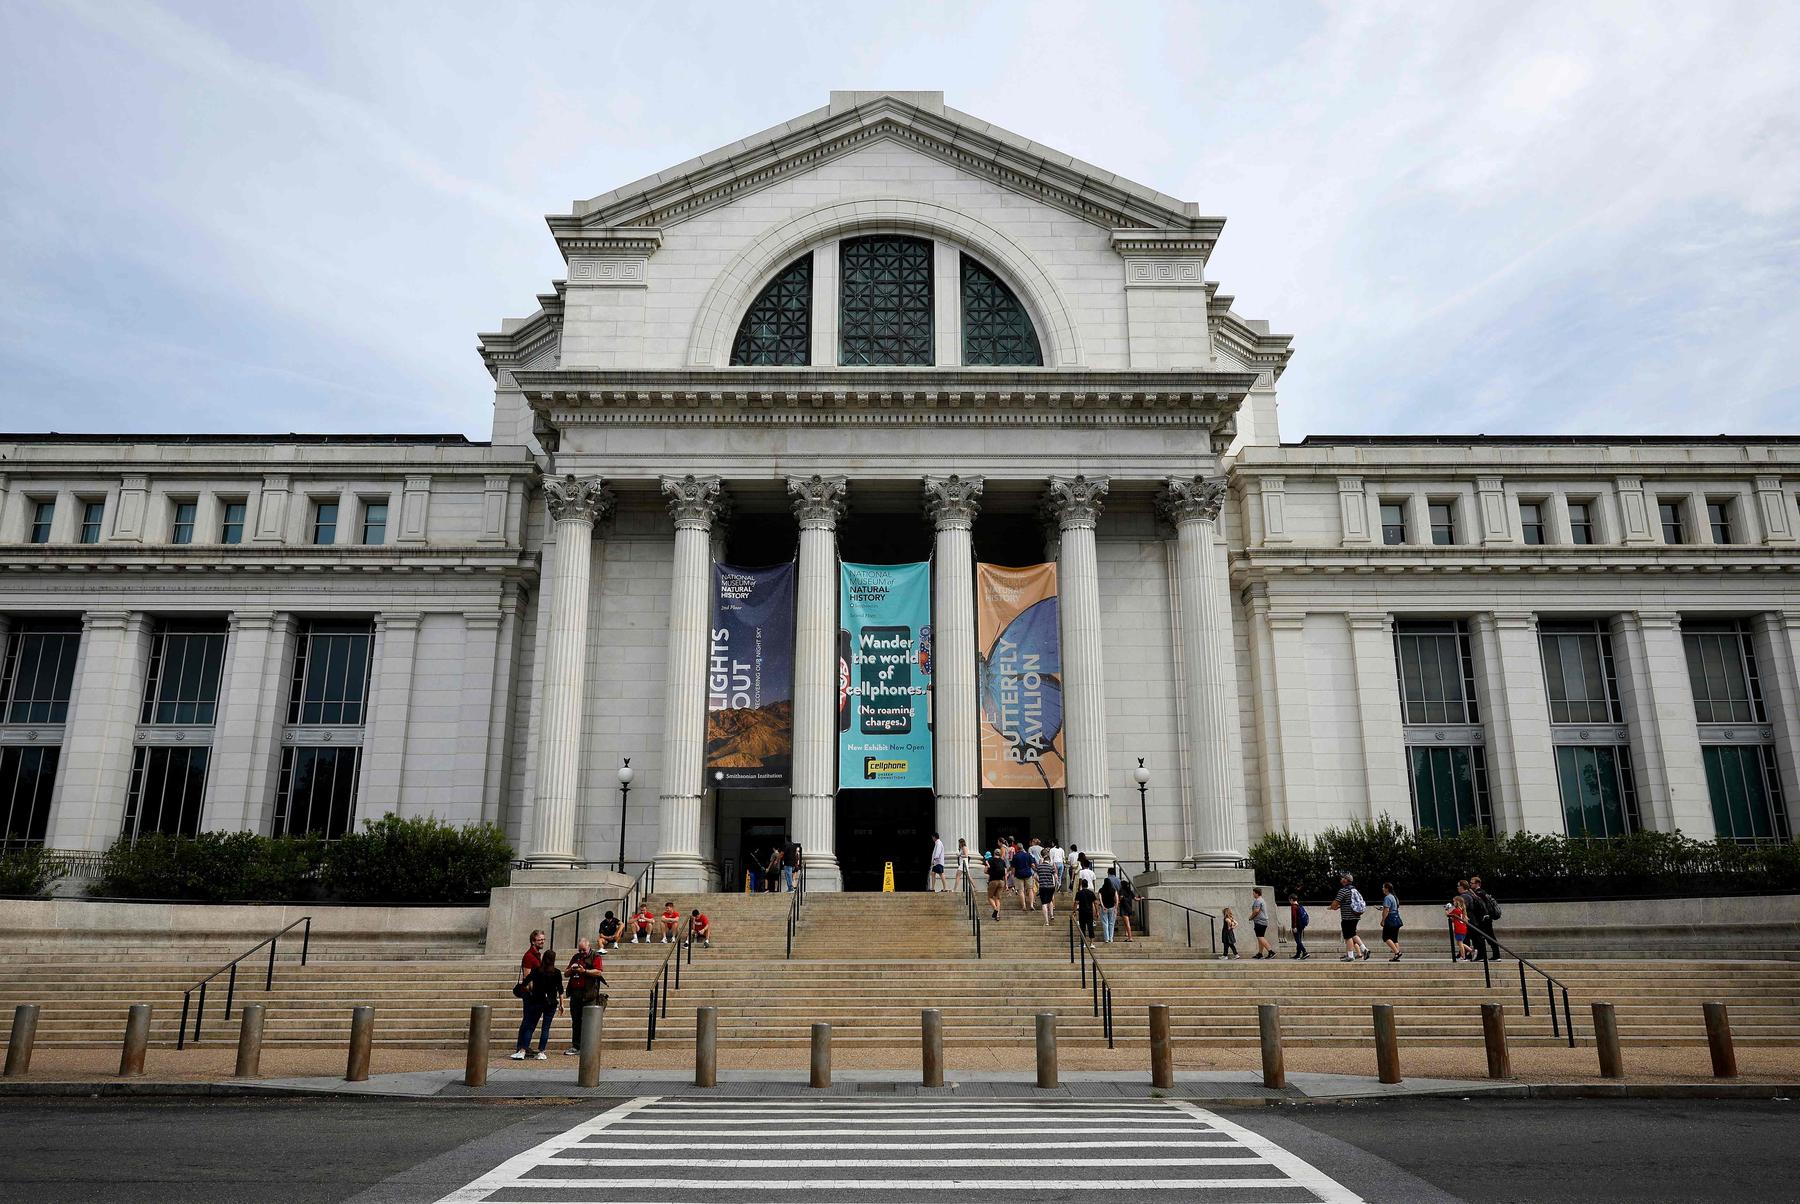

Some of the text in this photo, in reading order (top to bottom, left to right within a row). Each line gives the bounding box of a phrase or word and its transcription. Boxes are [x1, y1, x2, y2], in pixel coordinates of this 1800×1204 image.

[859, 634, 914, 649] Wander
[852, 650, 919, 664] the world
[709, 628, 729, 711] LIGHTS
[878, 665, 895, 680] of
[732, 660, 751, 710] OUT
[846, 681, 926, 701] cellphones.
[1000, 638, 1021, 762] BUTTERFLY
[1023, 654, 1044, 761] PAVILION
[857, 705, 915, 717] (No roaming
[866, 717, 906, 729] charges.)
[981, 712, 997, 761] LIVE
[870, 762, 906, 771] cellphone
